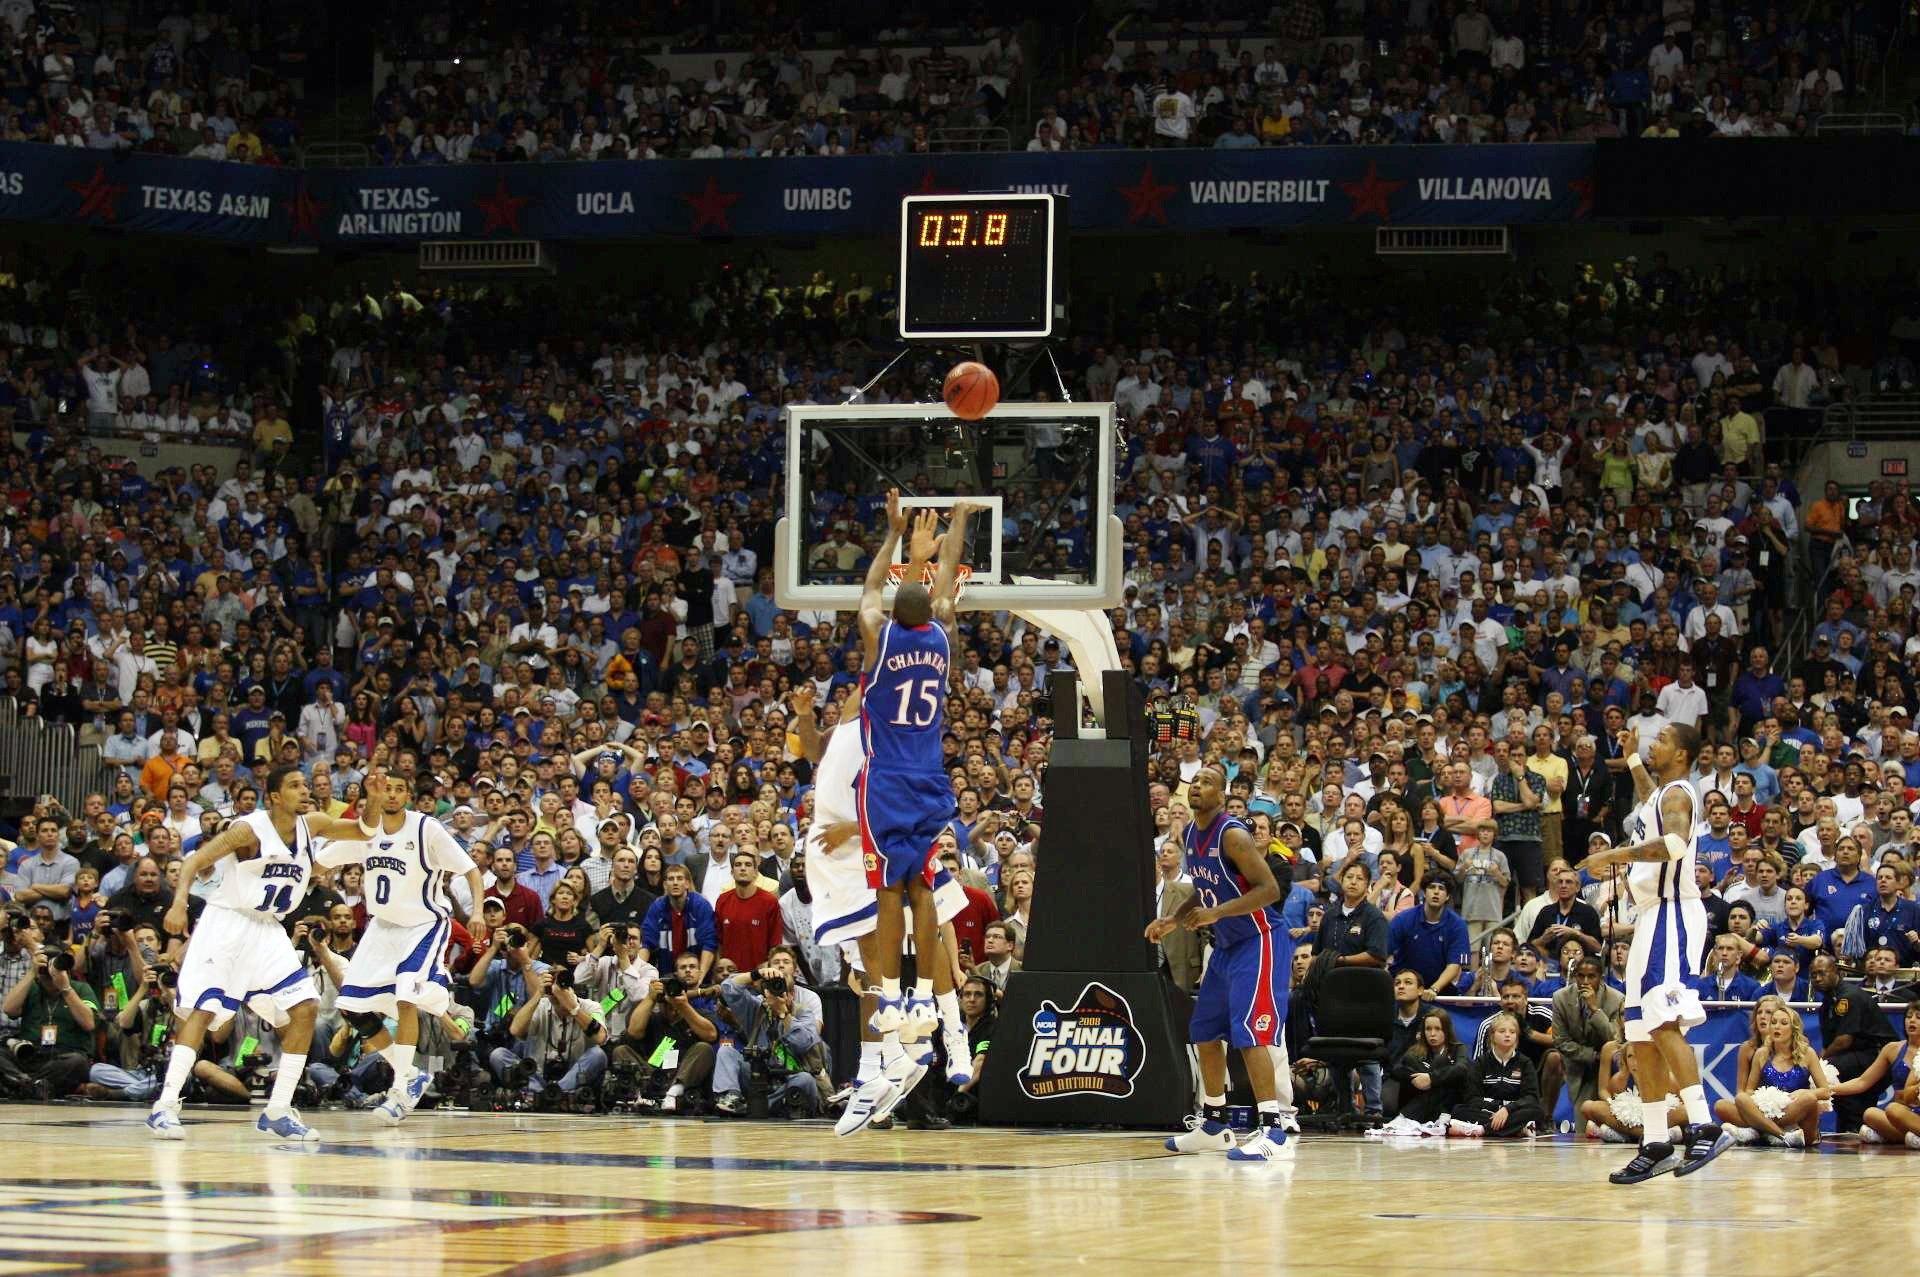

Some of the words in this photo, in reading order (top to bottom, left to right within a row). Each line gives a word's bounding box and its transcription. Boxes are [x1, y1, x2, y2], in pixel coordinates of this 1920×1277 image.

[359, 188, 440, 210] TEXAS-
[784, 188, 852, 211] UMBC
[1190, 180, 1329, 203] VANDERBILT
[1418, 177, 1552, 201] VILLANOVA
[142, 186, 212, 211] TEXAS
[218, 195, 270, 218] A&M
[577, 192, 635, 215] UCLA
[339, 211, 461, 235] ARLINGTON
[920, 214, 1007, 246] 03.8
[888, 651, 946, 676] CHALMERS
[890, 680, 940, 726] 15
[366, 856, 406, 876] MEMPHIS
[255, 884, 294, 914] 14
[375, 875, 391, 905] 0
[1057, 1021, 1125, 1046] FINAL
[1079, 1017, 1101, 1026] 2008
[1029, 1038, 1125, 1076] FOUR
[1032, 1080, 1053, 1094] SAN
[1057, 1077, 1104, 1091] ANTONIO
